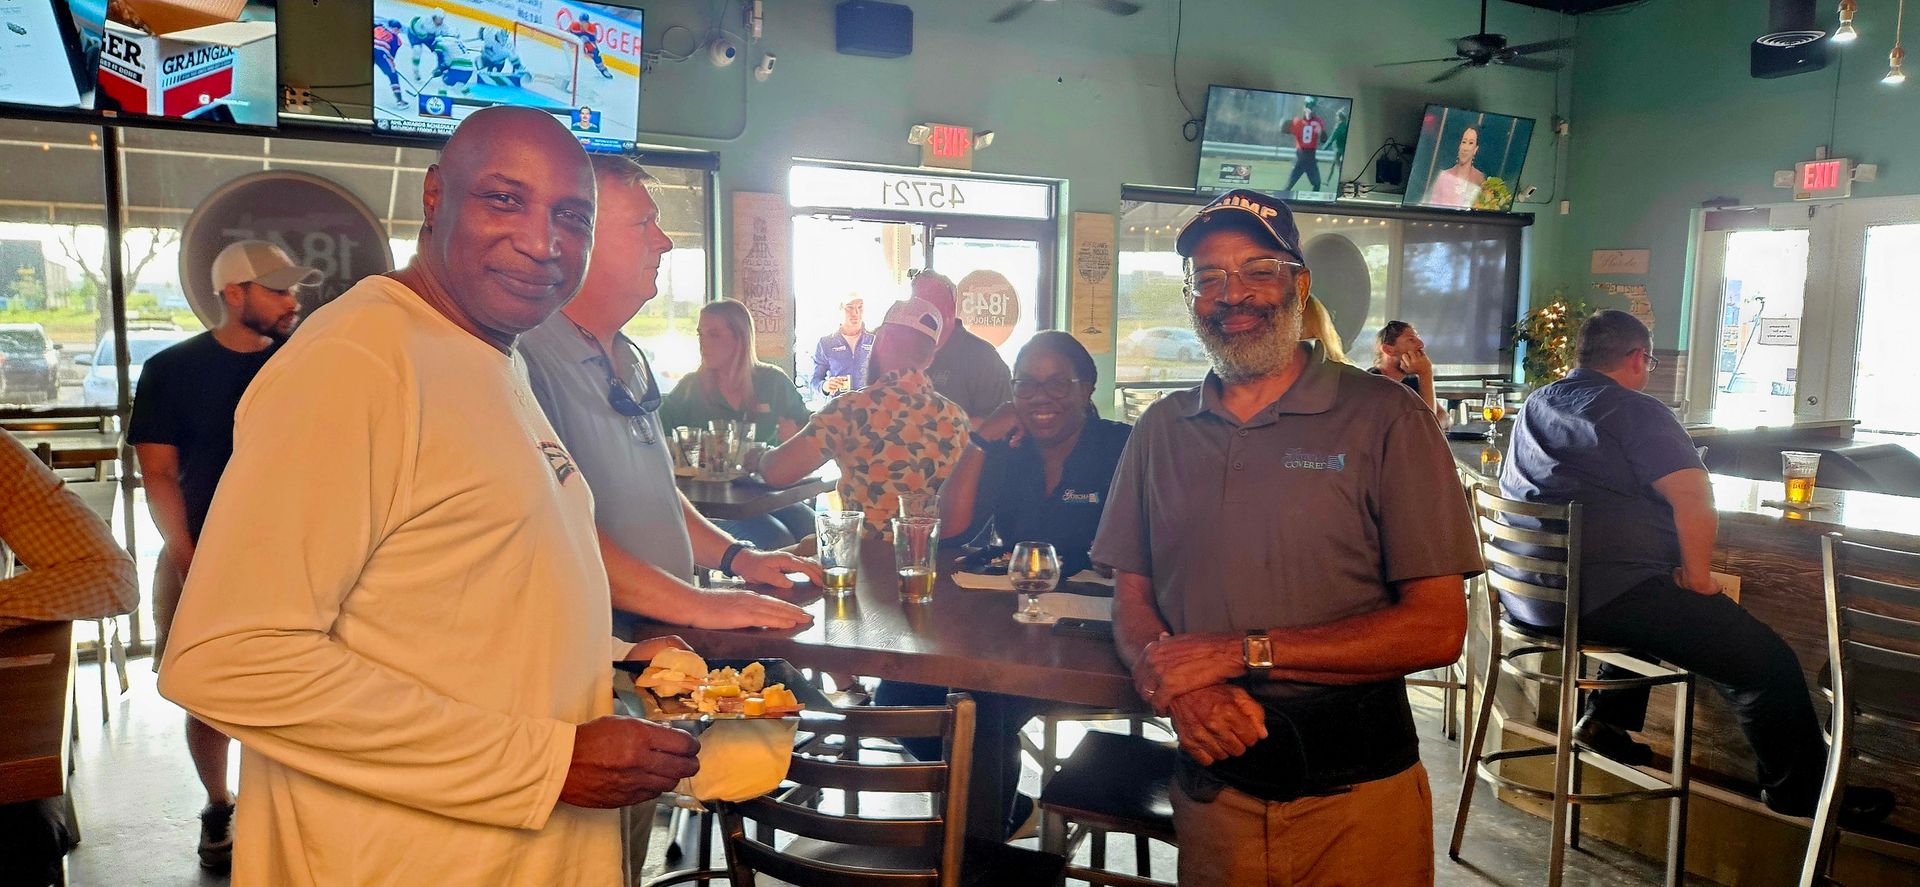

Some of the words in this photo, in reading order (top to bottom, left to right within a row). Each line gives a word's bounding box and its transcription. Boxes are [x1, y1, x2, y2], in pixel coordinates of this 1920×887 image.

[163, 44, 234, 75] GRAINGER
[933, 126, 968, 158] EXIT
[1302, 125, 1313, 144] 8
[1803, 161, 1840, 190] EXIT
[1284, 460, 1327, 470] COVERED
